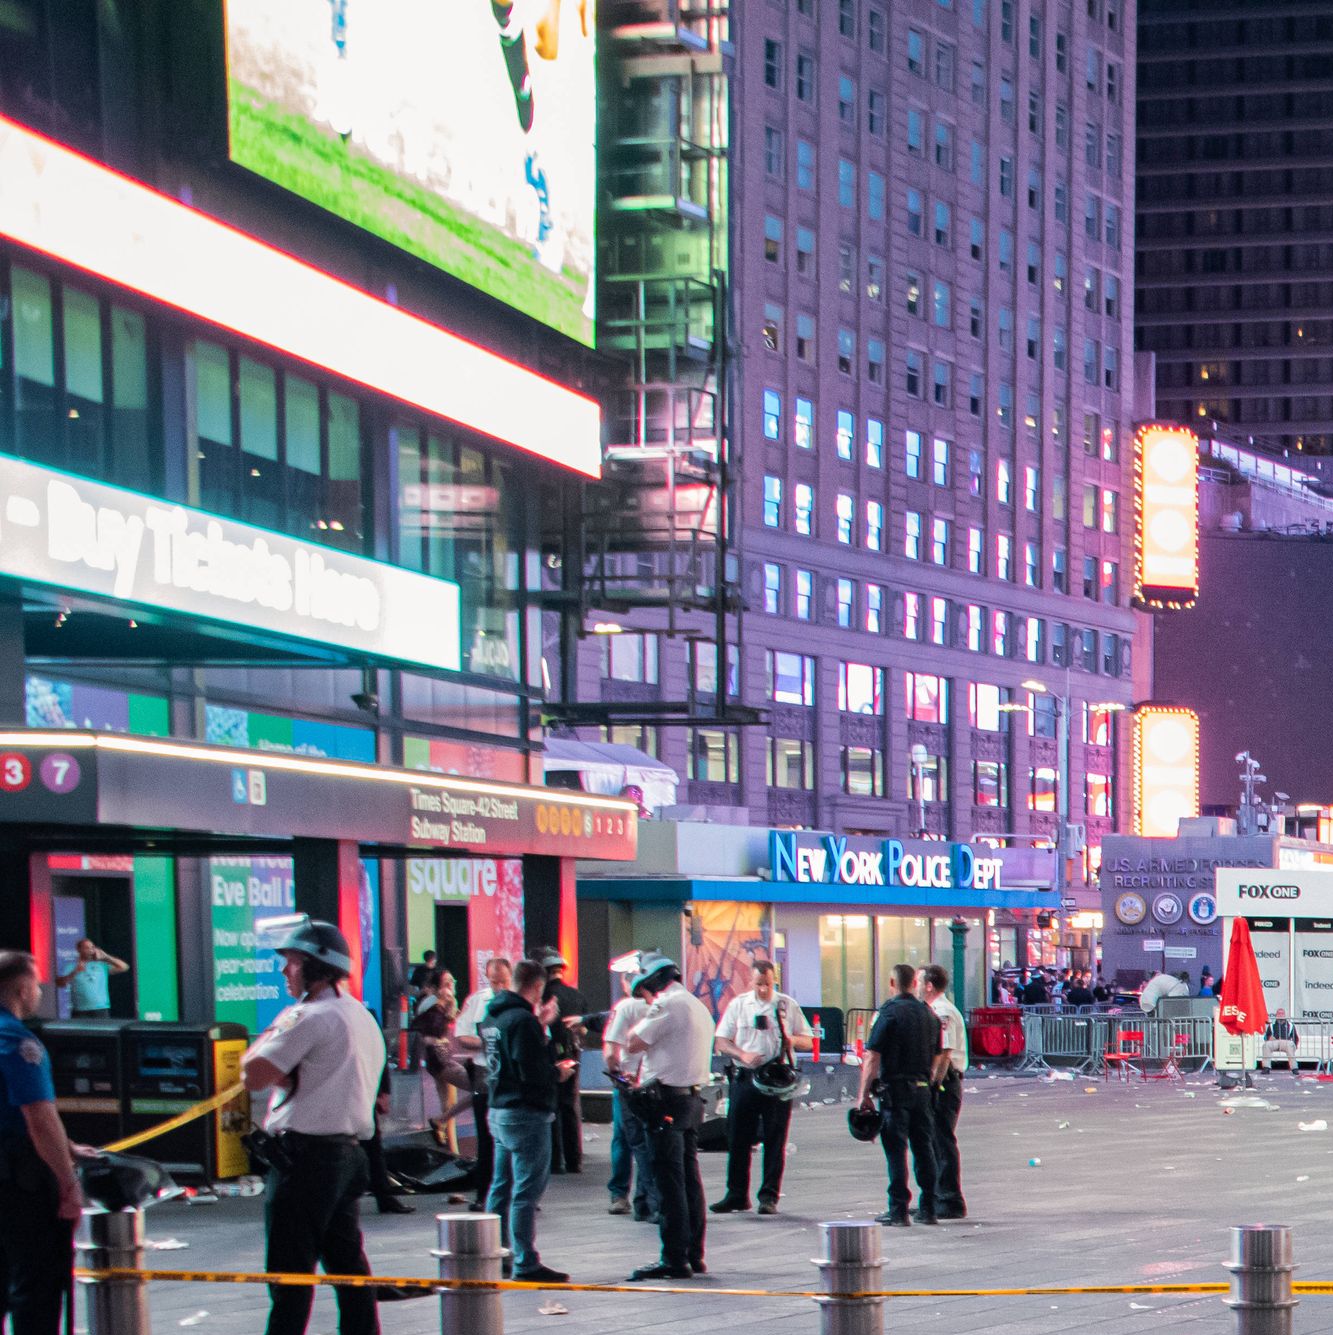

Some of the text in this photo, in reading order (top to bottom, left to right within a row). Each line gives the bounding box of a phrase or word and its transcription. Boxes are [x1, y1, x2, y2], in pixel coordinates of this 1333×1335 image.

[47, 480, 144, 598] Buy
[146, 506, 293, 611] Tickets
[4, 760, 24, 785] 3
[53, 761, 70, 785] 7
[411, 788, 441, 812] Times
[489, 799, 518, 820] Street
[411, 816, 486, 845] Subway Station
[1107, 859, 1133, 872] U.S.
[1137, 858, 1197, 873] ARMED
[212, 875, 245, 907] Eve
[247, 877, 282, 907] Ball
[410, 858, 498, 900] square
[1114, 876, 1197, 888] RECRUITING
[1239, 885, 1299, 898] FOX ONE
[214, 928, 238, 946] Now
[216, 982, 279, 1000] celebrations
[1303, 1011, 1319, 1019] FOX
